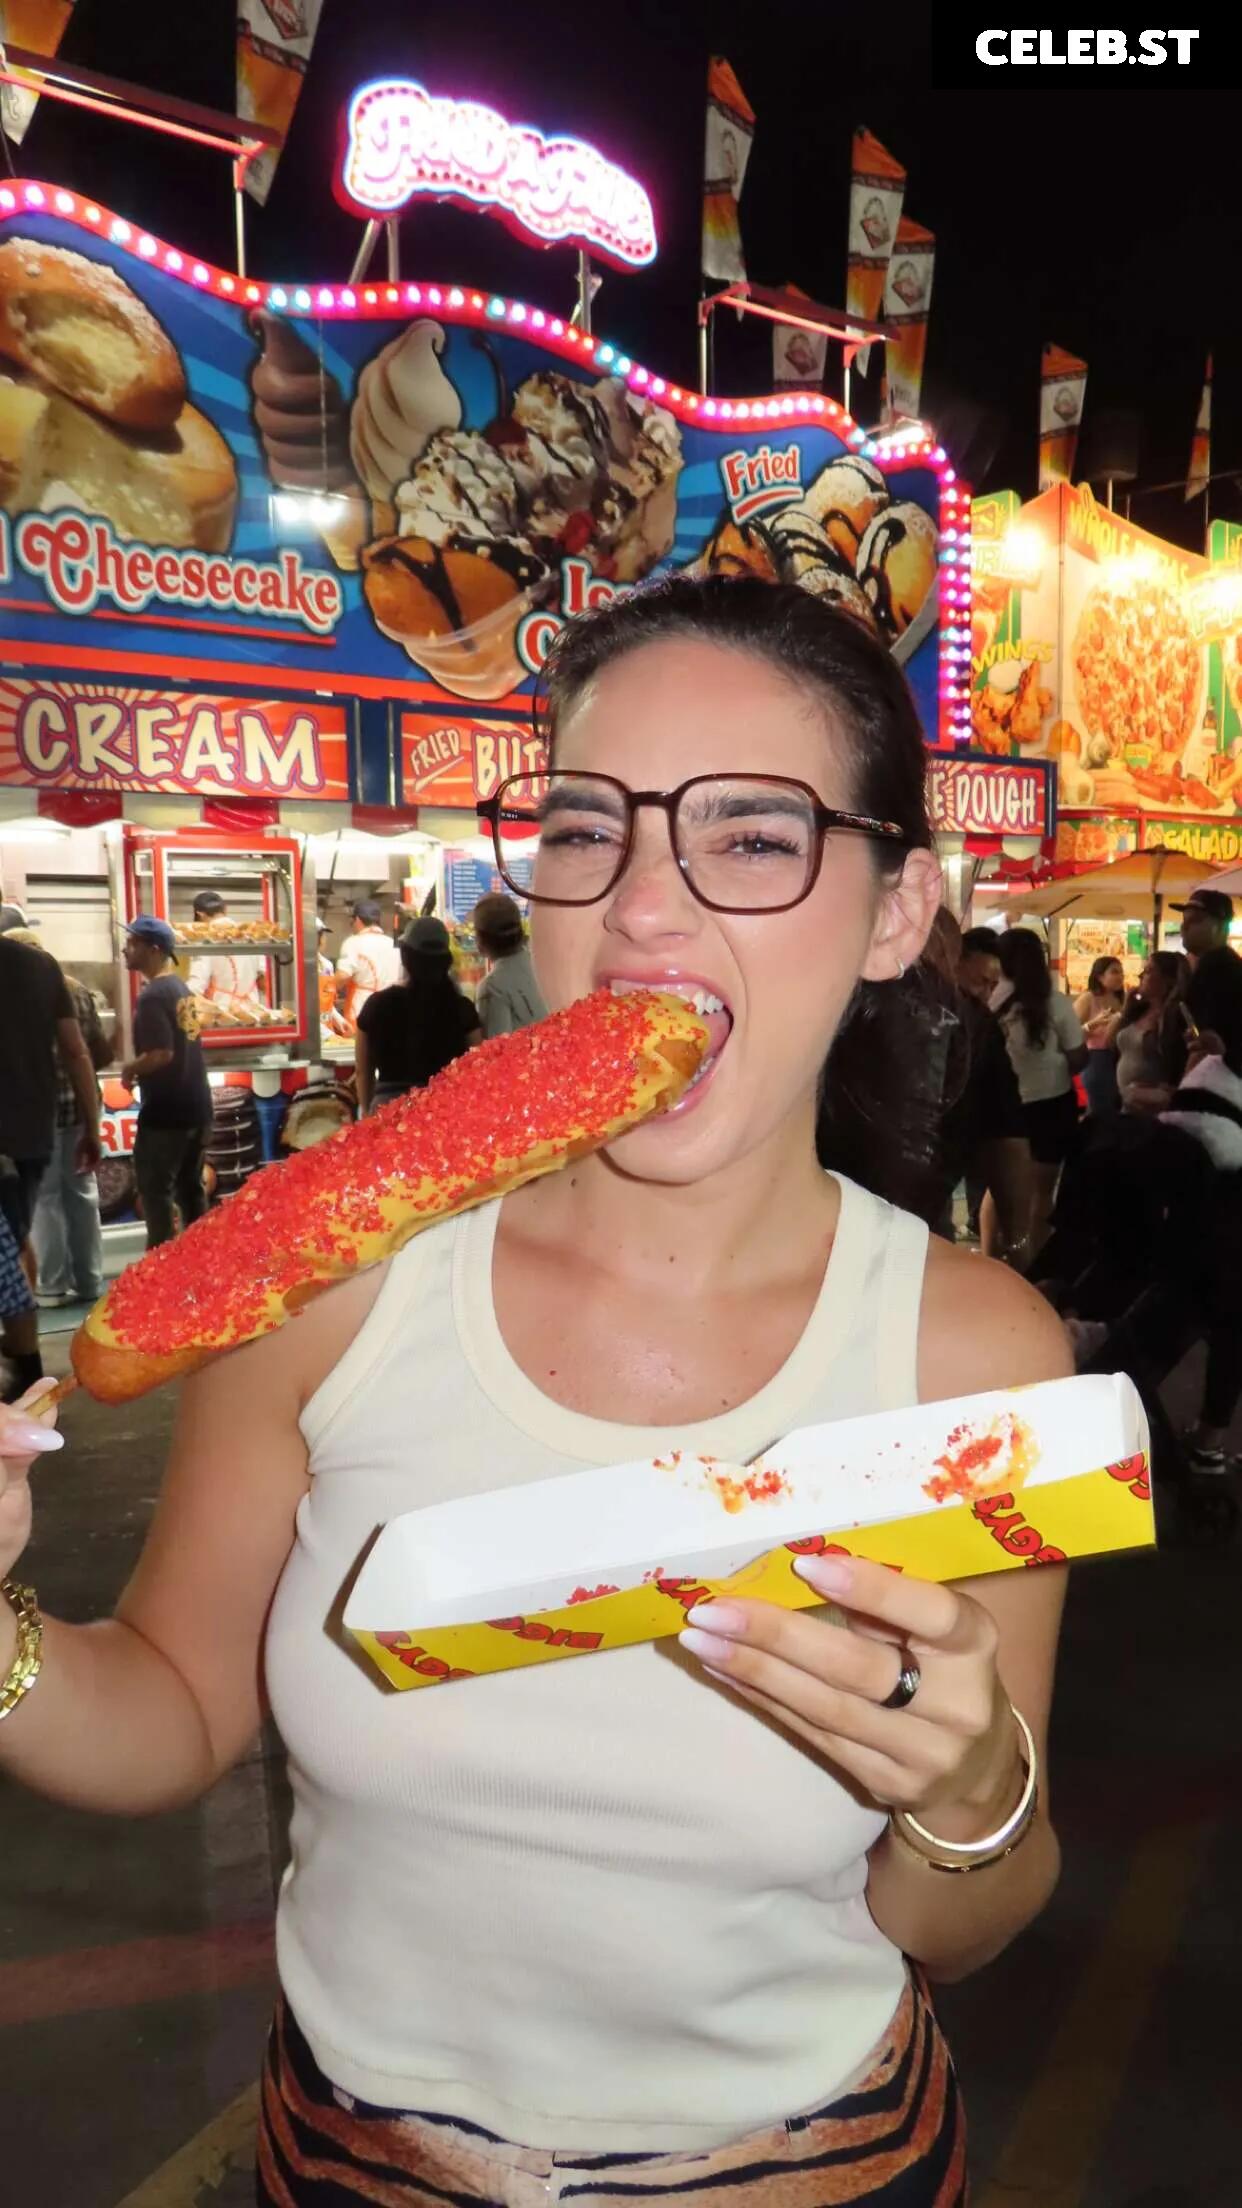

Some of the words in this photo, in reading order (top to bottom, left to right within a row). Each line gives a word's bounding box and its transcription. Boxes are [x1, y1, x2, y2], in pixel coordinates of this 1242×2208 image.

[725, 447, 798, 497] Fried
[22, 519, 338, 625] Cheesecake
[22, 697, 320, 787] CREAM
[410, 728, 460, 776] FRIED
[475, 734, 549, 798] BUT
[956, 773, 1036, 826] DOUGH
